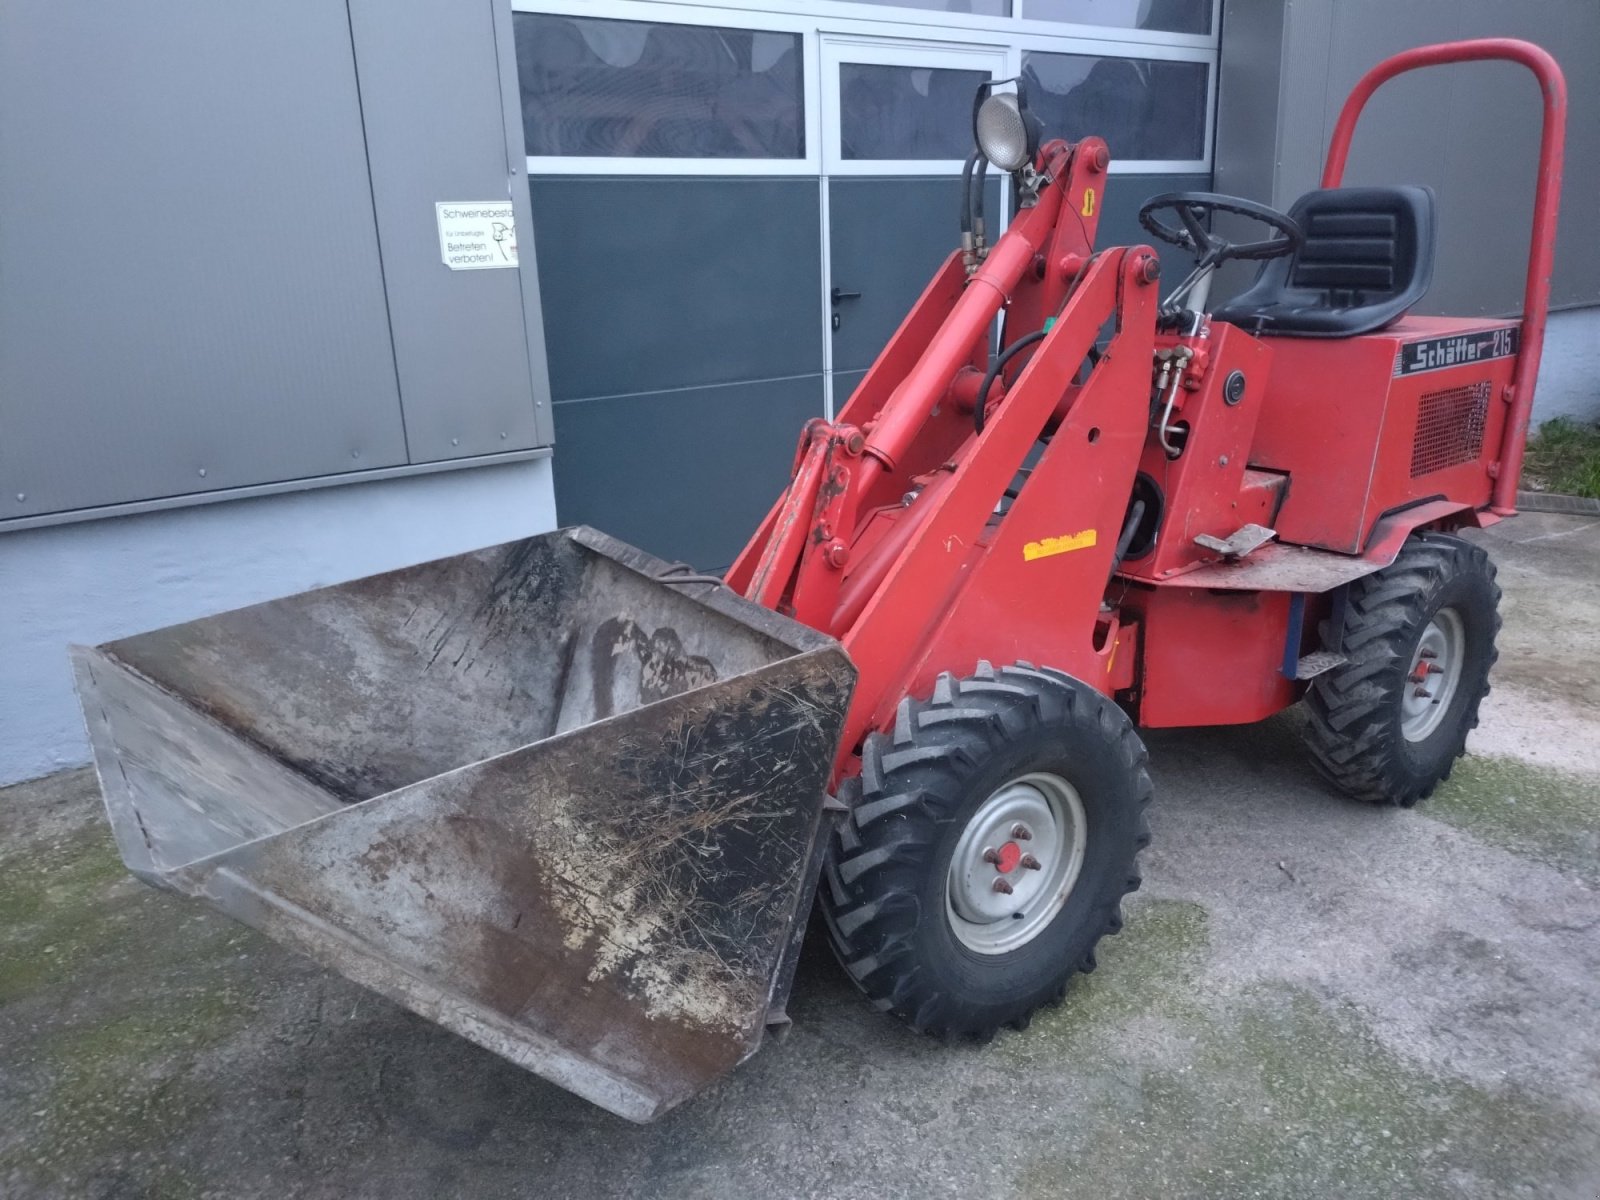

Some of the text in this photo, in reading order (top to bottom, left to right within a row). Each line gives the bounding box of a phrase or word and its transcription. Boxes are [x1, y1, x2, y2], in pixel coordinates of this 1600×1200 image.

[447, 242, 487, 252] Betreten
[449, 253, 493, 263] verboten!
[1410, 330, 1511, 370] Schäffer 215
